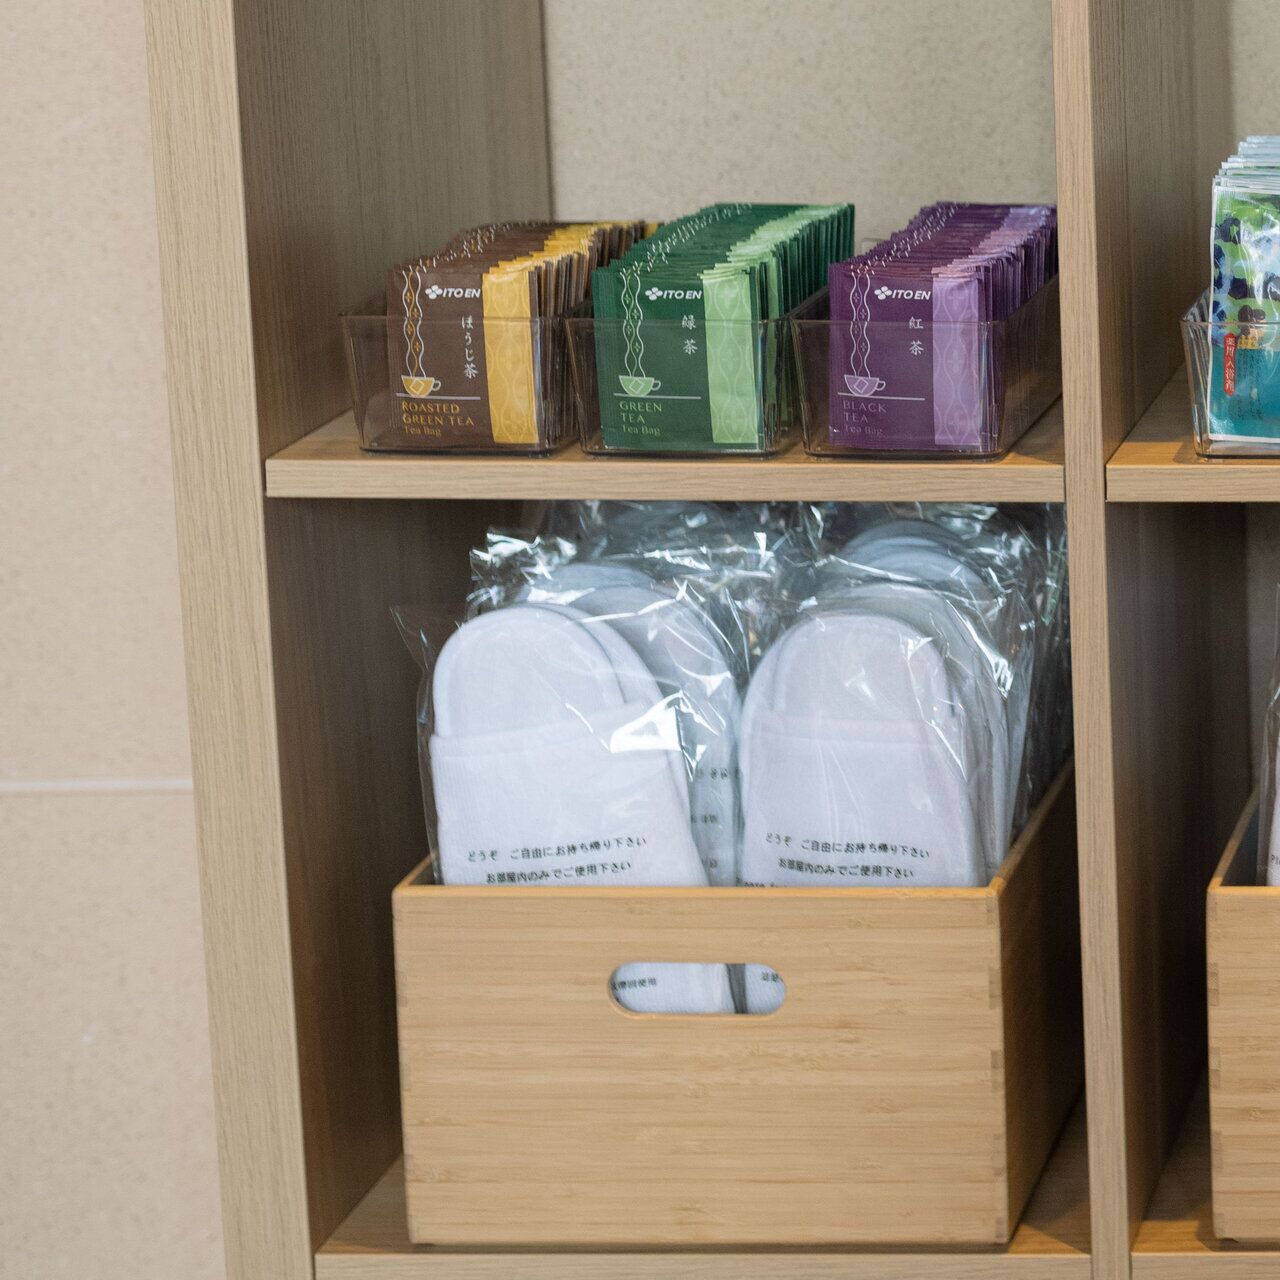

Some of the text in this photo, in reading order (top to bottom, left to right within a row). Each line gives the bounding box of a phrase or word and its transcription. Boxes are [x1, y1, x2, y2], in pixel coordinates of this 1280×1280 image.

[442, 288, 480, 298] ITO EN
[663, 289, 702, 300] ITO EN
[892, 290, 931, 300] ITO EN
[681, 315, 698, 355] 緑茶
[909, 316, 924, 355] 紅茶
[461, 315, 479, 379] ほうじ茶
[401, 401, 460, 414] ROASTED
[619, 400, 662, 412] GREEN
[843, 400, 887, 413] BLACK
[402, 414, 474, 427] GREEN TEA
[621, 412, 645, 424] TEA
[844, 412, 869, 424] TEA
[405, 426, 442, 438] Tea Bag
[622, 425, 661, 436] Tea Bag
[844, 424, 862, 433] Tea
[765, 832, 792, 847] どうぞ
[467, 848, 498, 862] どうぞ
